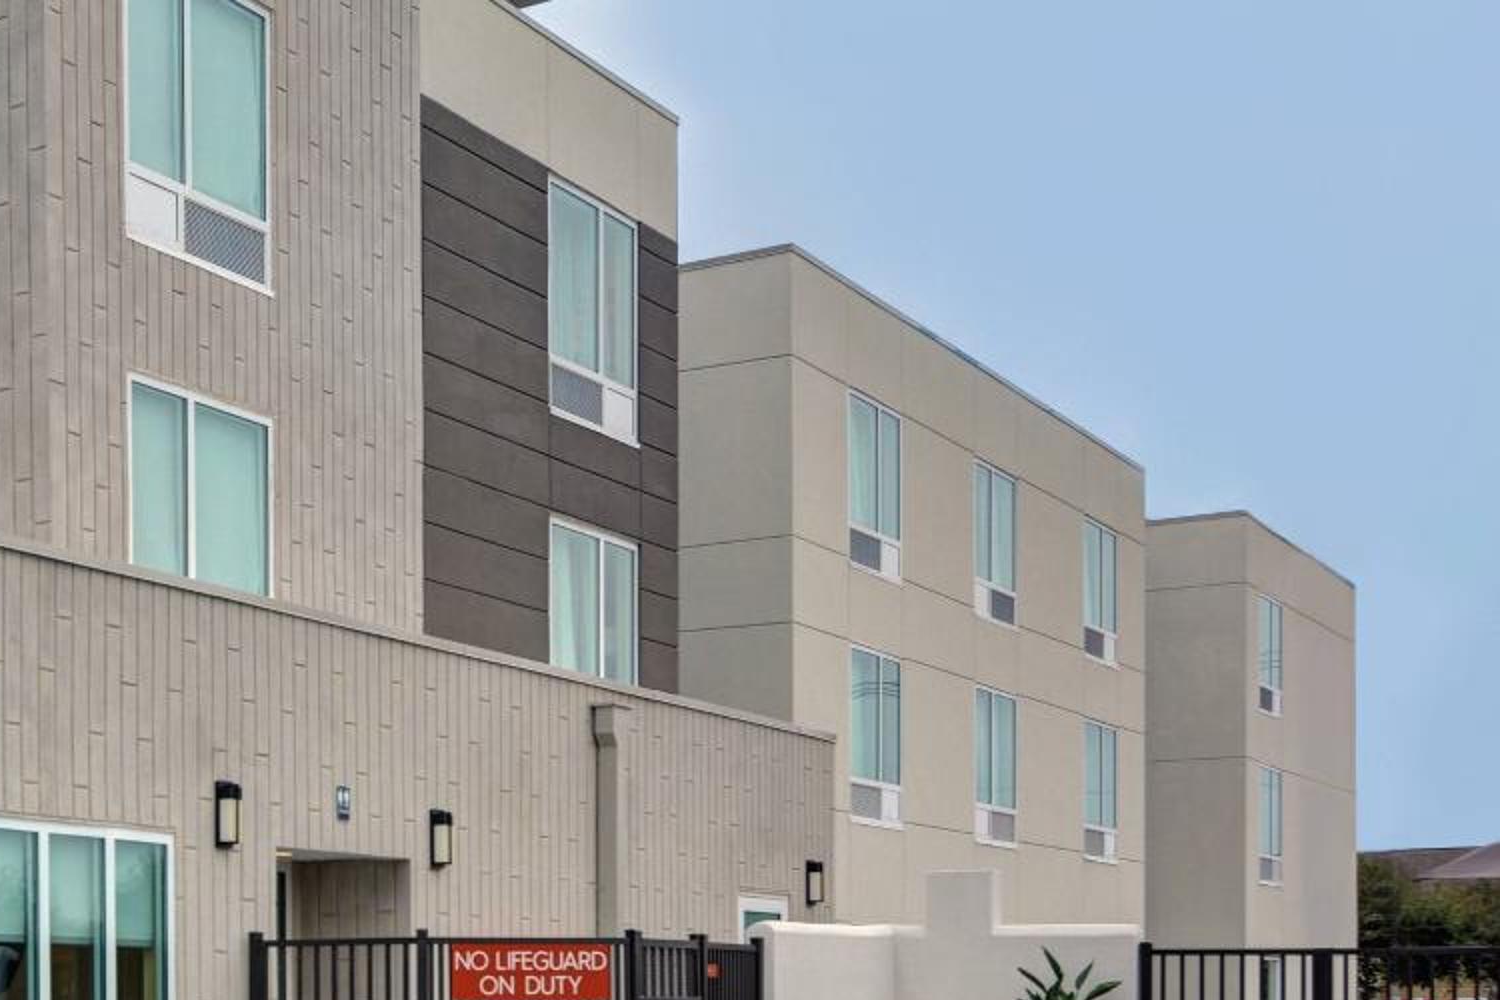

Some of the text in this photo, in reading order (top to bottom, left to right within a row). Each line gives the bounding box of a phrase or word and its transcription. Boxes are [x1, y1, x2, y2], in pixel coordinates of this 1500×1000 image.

[453, 950, 608, 972] NO LIFEGUARD
[478, 975, 583, 996] ON DUTY
